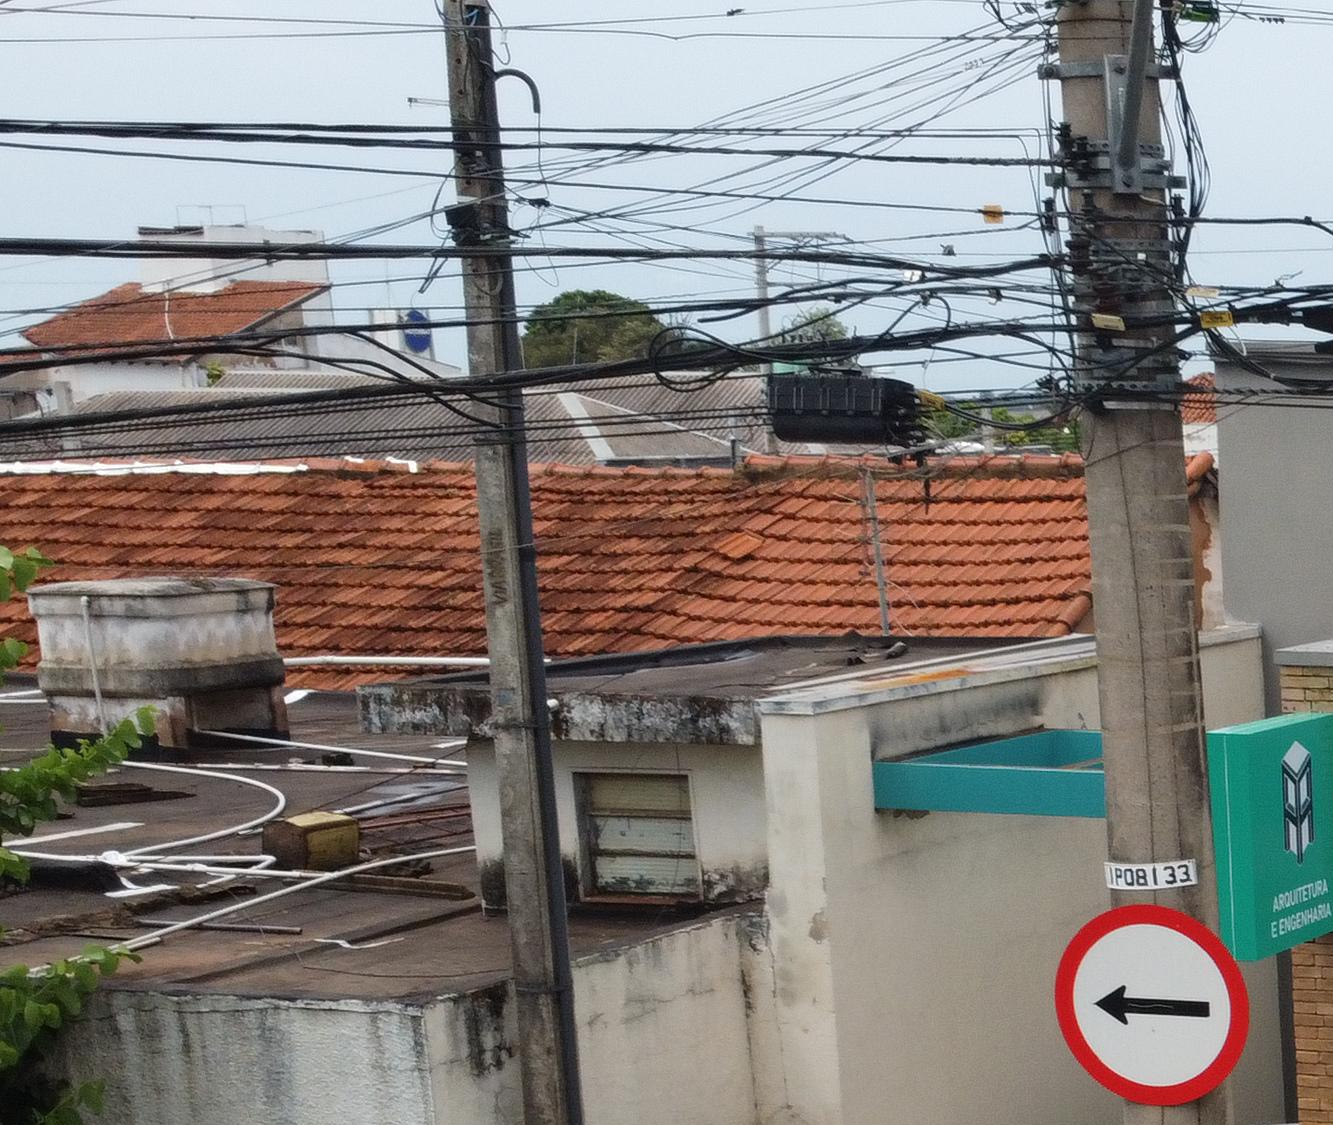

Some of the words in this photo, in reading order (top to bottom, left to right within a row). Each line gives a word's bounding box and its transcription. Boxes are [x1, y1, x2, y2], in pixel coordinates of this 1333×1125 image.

[1273, 879, 1329, 912] ARQUITETURA
[1271, 921, 1278, 938] E
[1279, 902, 1332, 935] ENGENHARIA
